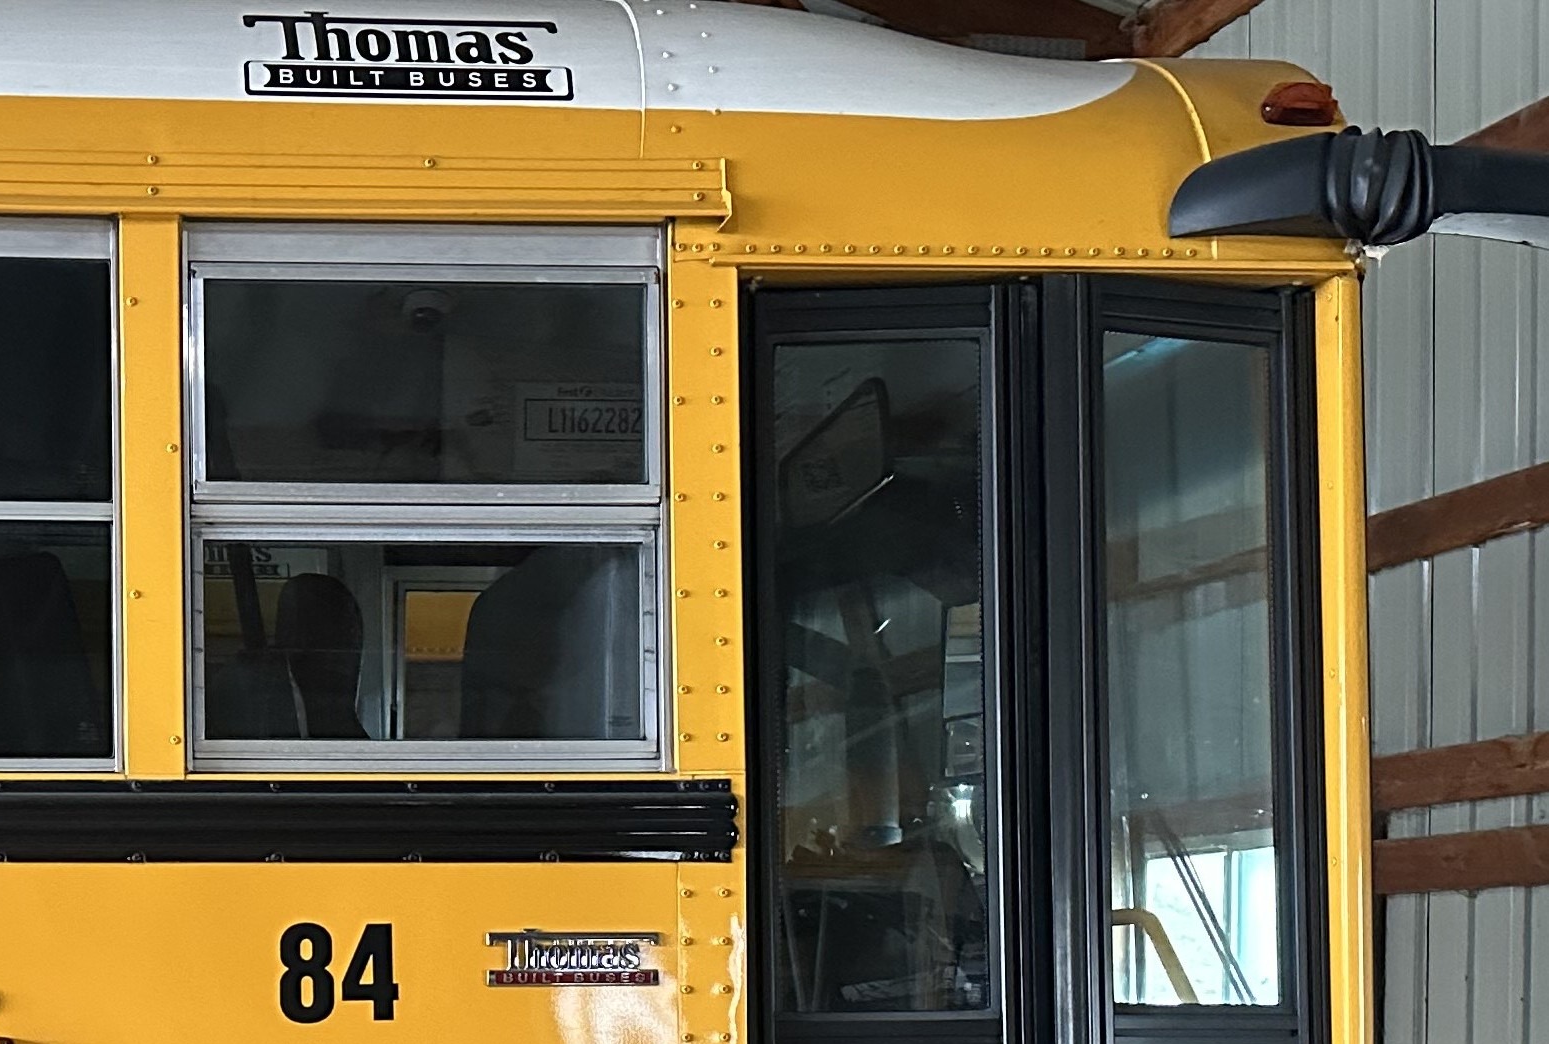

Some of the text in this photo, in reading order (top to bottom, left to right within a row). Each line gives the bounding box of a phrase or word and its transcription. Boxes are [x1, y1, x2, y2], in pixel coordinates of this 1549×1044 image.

[243, 11, 557, 65] Thomas
[279, 69, 537, 88] BUILT BUSES
[547, 407, 642, 434] L1162282
[485, 928, 659, 971] Thomas
[279, 923, 399, 1024] 84
[502, 972, 646, 983] BUILT BUSES
